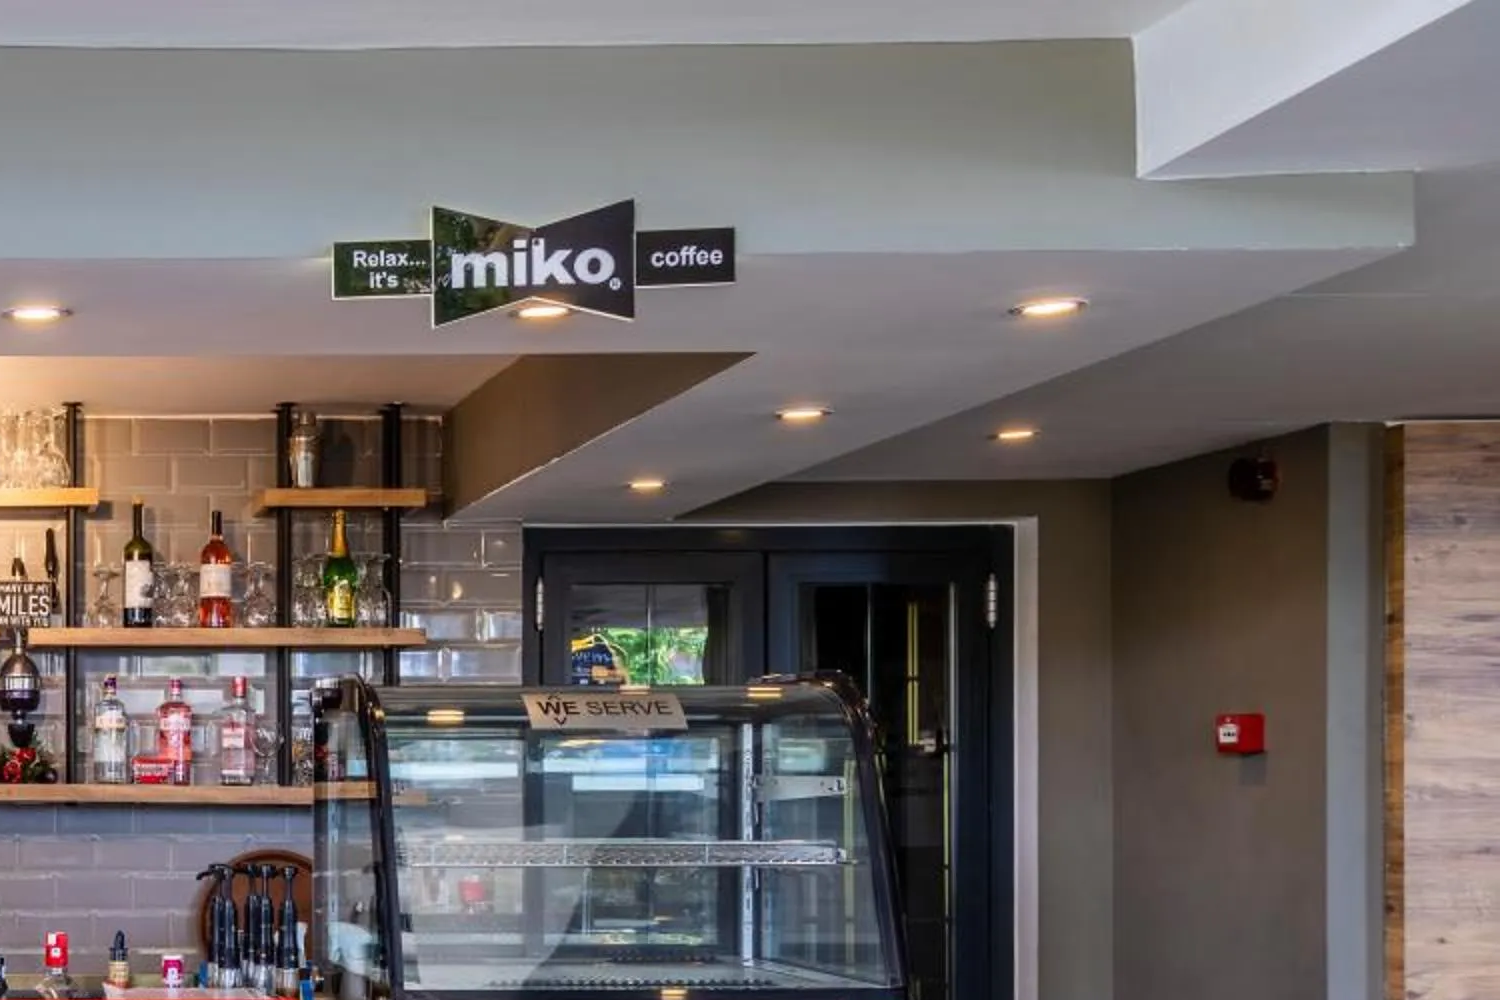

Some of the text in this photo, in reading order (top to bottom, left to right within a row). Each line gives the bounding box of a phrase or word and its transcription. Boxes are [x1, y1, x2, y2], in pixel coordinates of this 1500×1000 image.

[353, 250, 426, 268] Relax...
[651, 244, 723, 268] coffee
[369, 272, 398, 288] it's
[537, 700, 673, 716] WE SERVE
